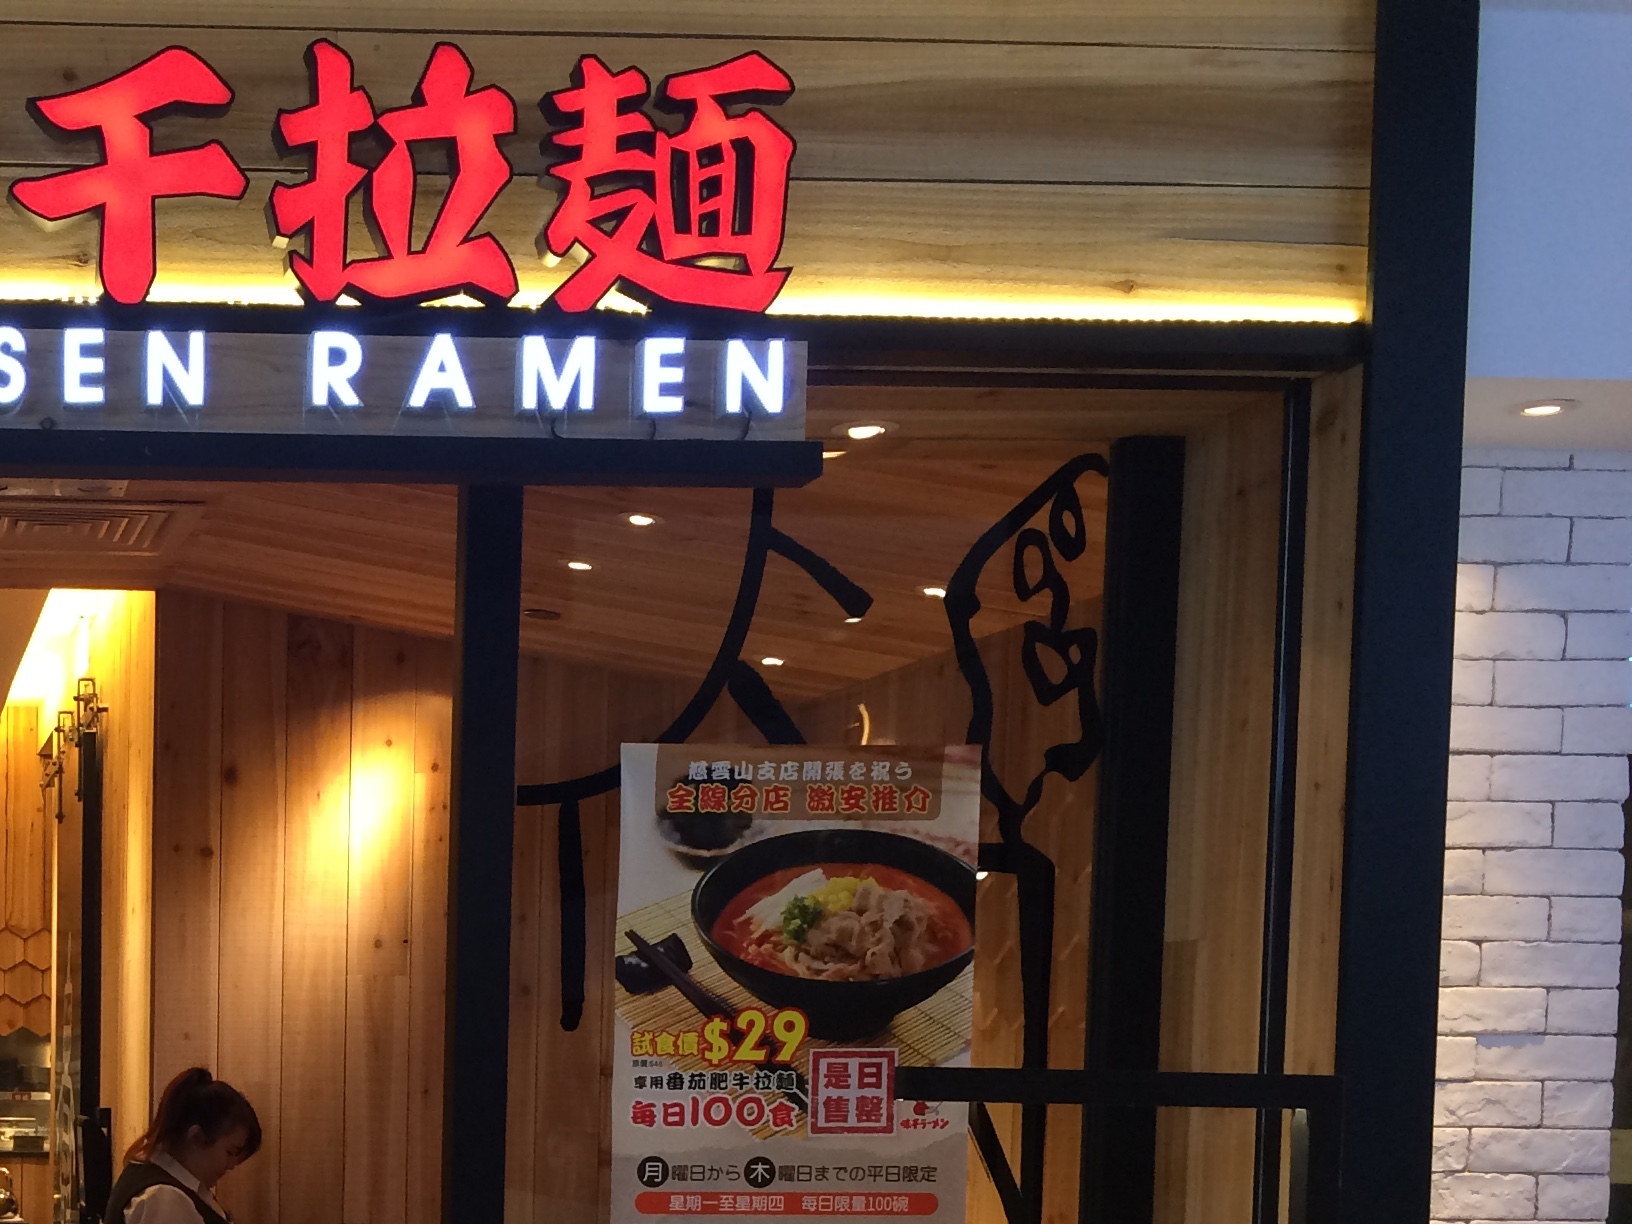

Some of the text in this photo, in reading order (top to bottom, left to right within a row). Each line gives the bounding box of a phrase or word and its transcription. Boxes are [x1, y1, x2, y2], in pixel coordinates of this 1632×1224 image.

[306, 329, 786, 415] RAMEN
[666, 783, 792, 814] 全線分店
[701, 1005, 810, 1068] $29
[824, 1062, 883, 1089] 是日
